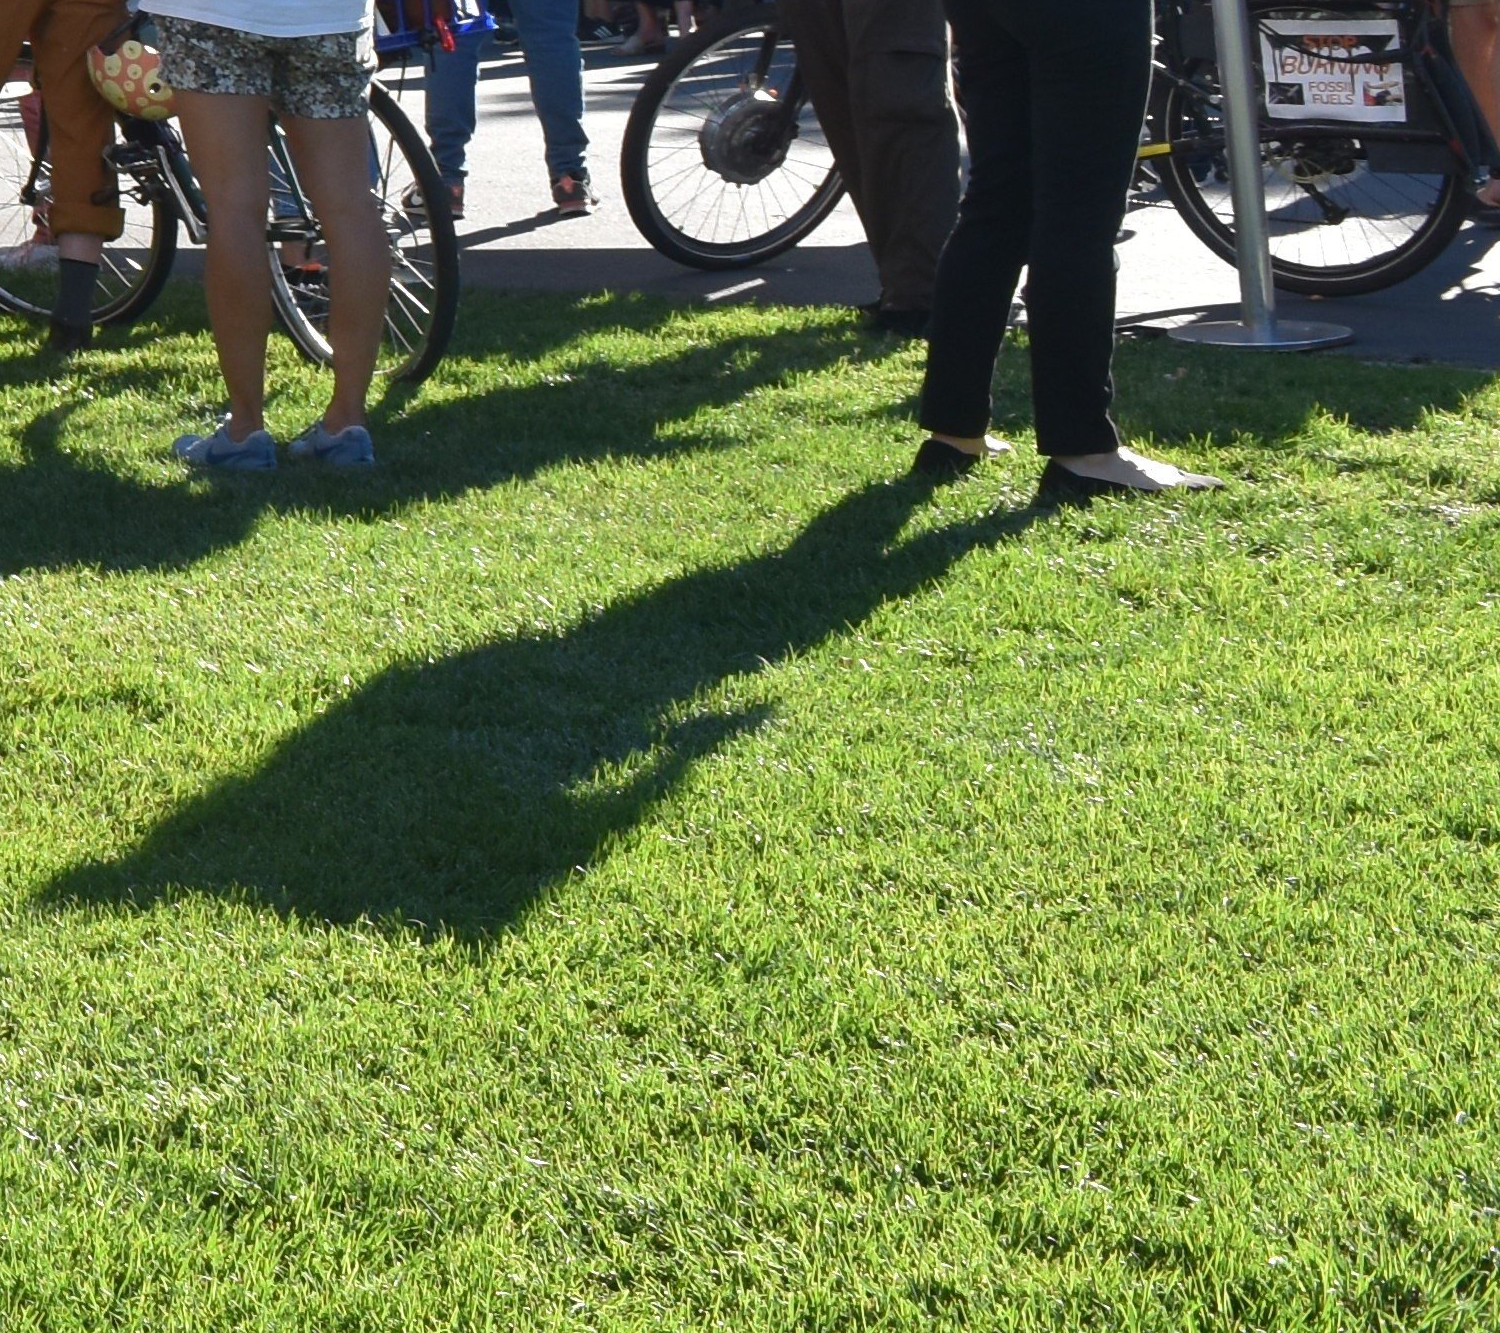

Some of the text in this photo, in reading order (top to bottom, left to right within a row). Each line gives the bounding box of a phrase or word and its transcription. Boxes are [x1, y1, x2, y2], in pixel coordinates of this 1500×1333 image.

[1303, 35, 1358, 49] STOP
[1308, 81, 1354, 93] FOSSIL
[1312, 94, 1355, 106] FUELS
